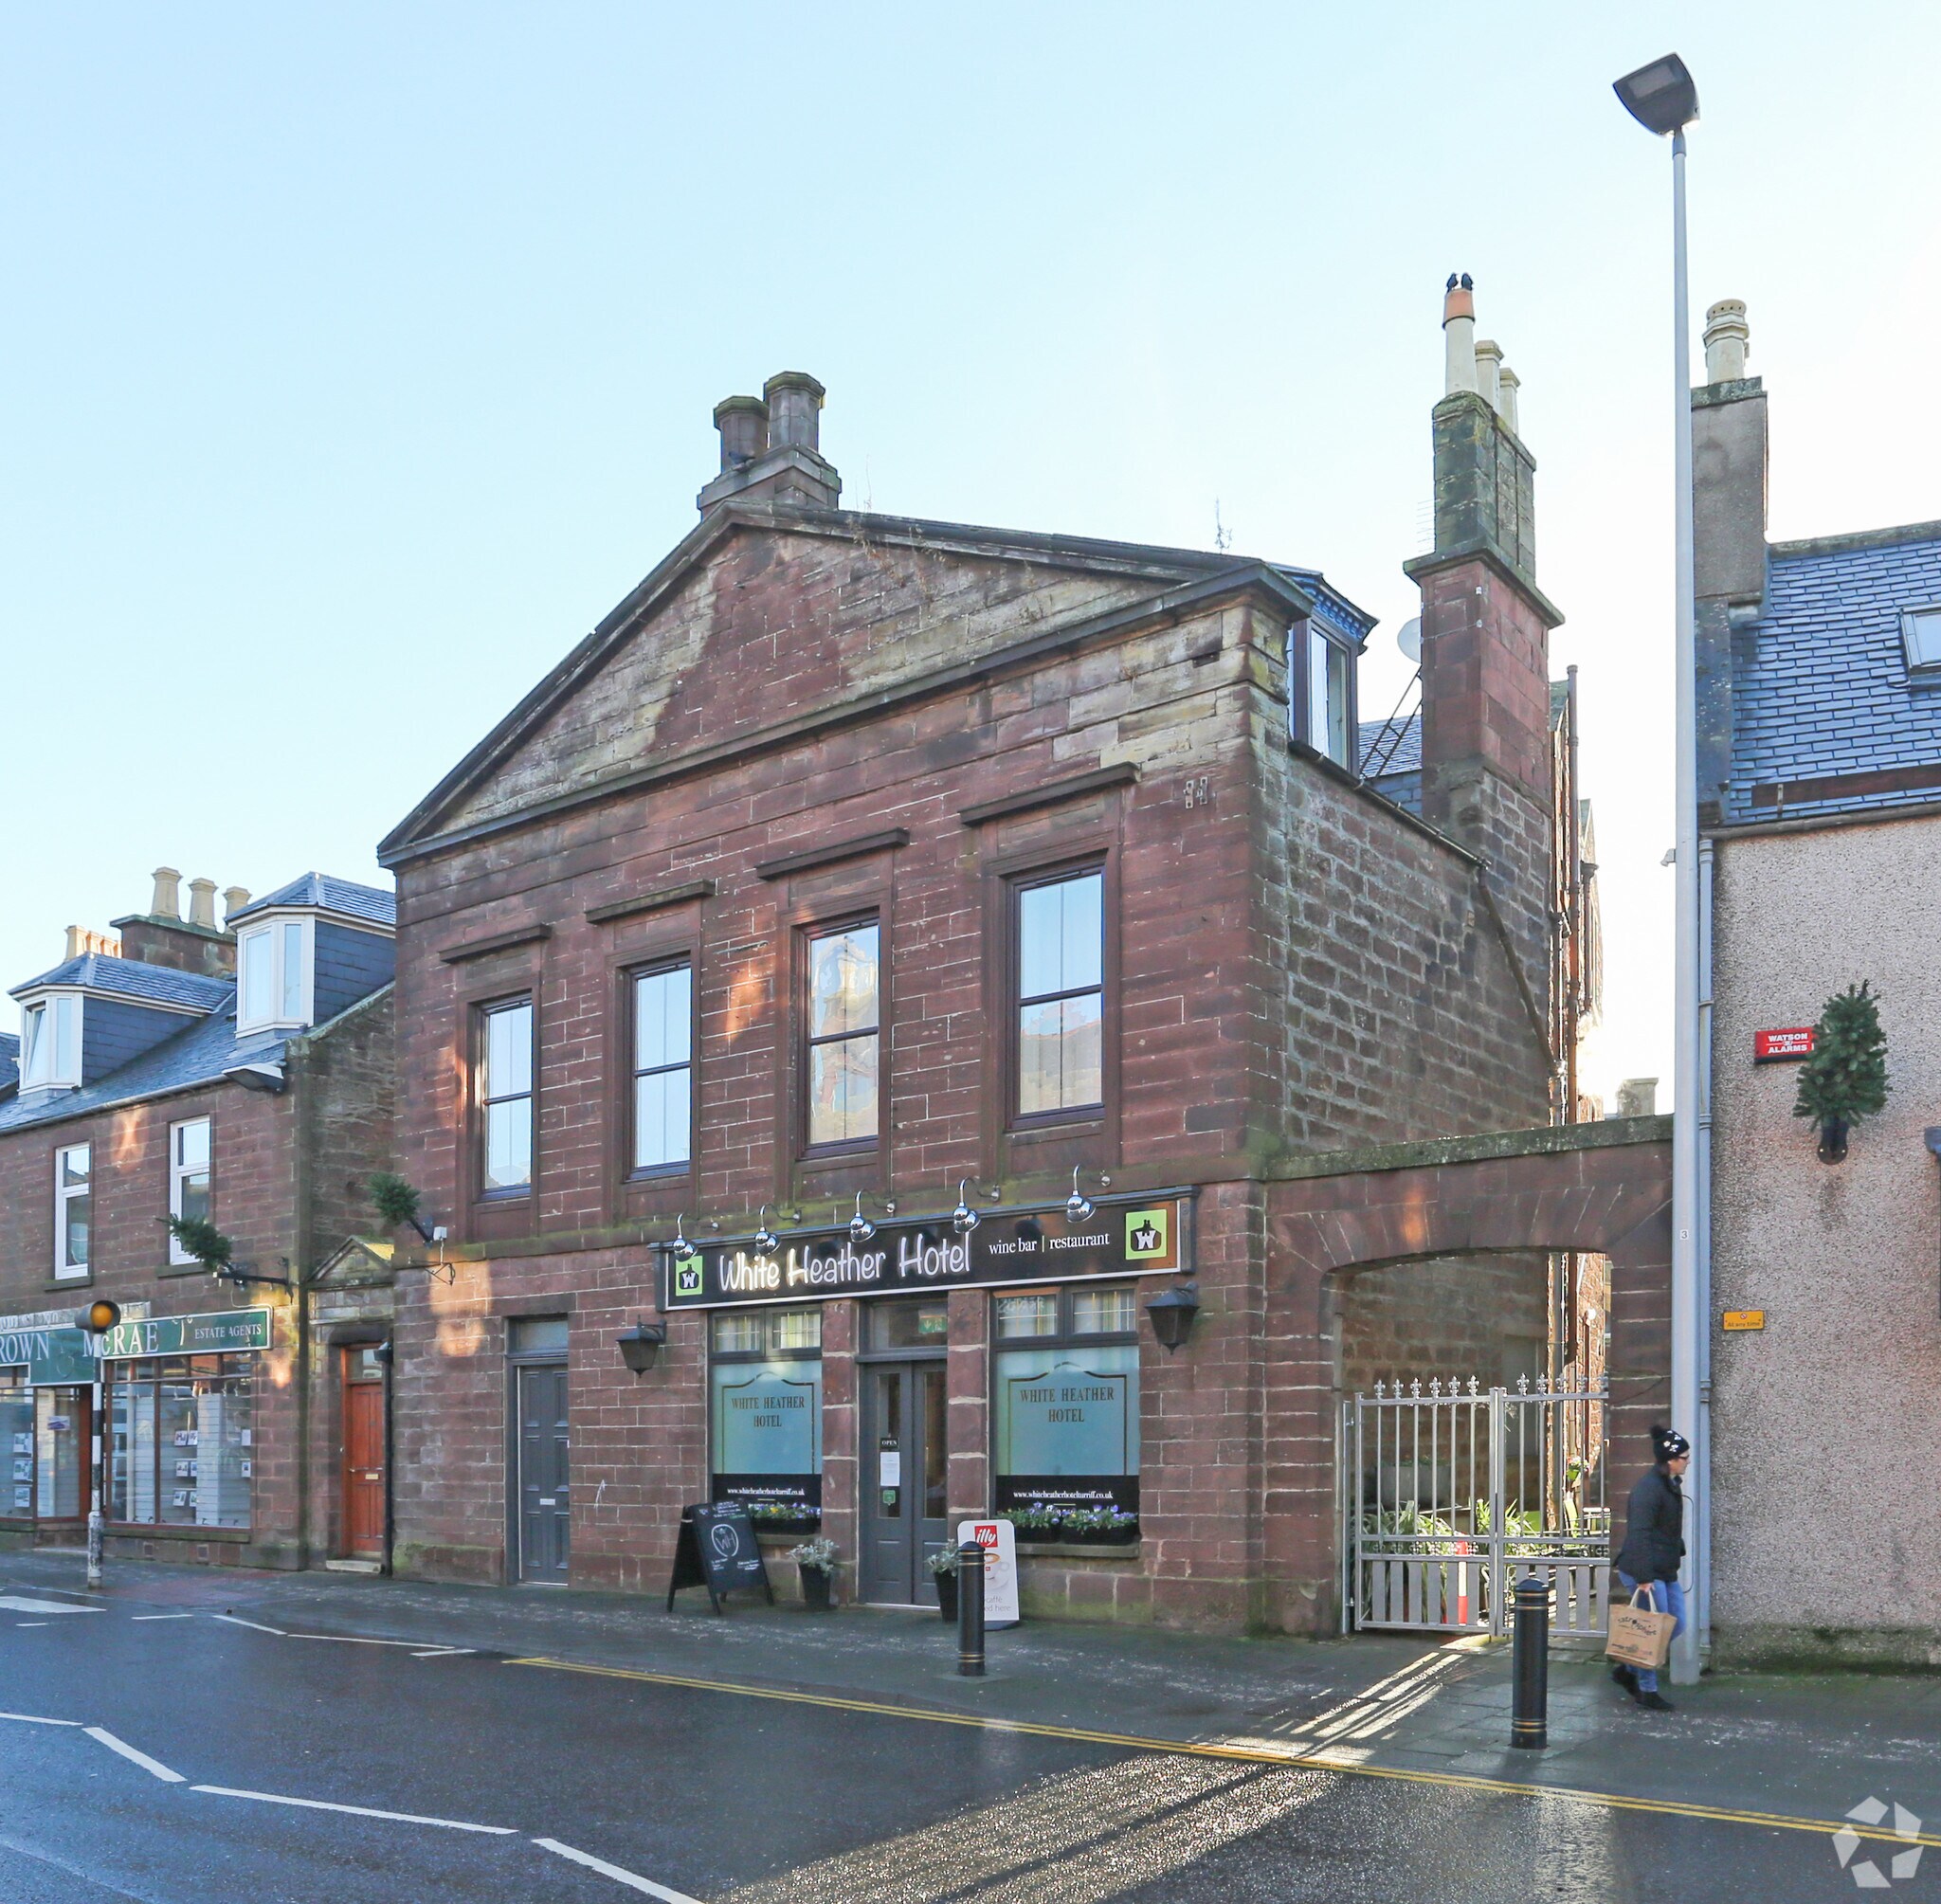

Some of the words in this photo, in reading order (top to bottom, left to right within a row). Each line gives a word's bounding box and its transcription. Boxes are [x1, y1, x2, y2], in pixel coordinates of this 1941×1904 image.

[1768, 1033, 1807, 1043] WATSON
[1768, 1044, 1807, 1054] ALARMS
[1681, 1230, 1688, 1239] 3
[989, 1240, 1017, 1255] wine
[1018, 1236, 1038, 1253] bar
[1049, 1232, 1110, 1250] restaurant
[718, 1251, 780, 1291] White
[788, 1241, 886, 1287] Heather
[899, 1231, 970, 1278] Hotel
[194, 1327, 226, 1339] ESTATE
[228, 1323, 262, 1336] AGENTS
[1020, 1388, 1055, 1403] WHITE
[1061, 1387, 1115, 1402] HEATHER
[732, 1397, 759, 1409] WHITE
[764, 1396, 805, 1408] HEATHER
[753, 1415, 782, 1427] HOTEL
[1048, 1408, 1084, 1422] HOTEL
[976, 1528, 997, 1546] illy
